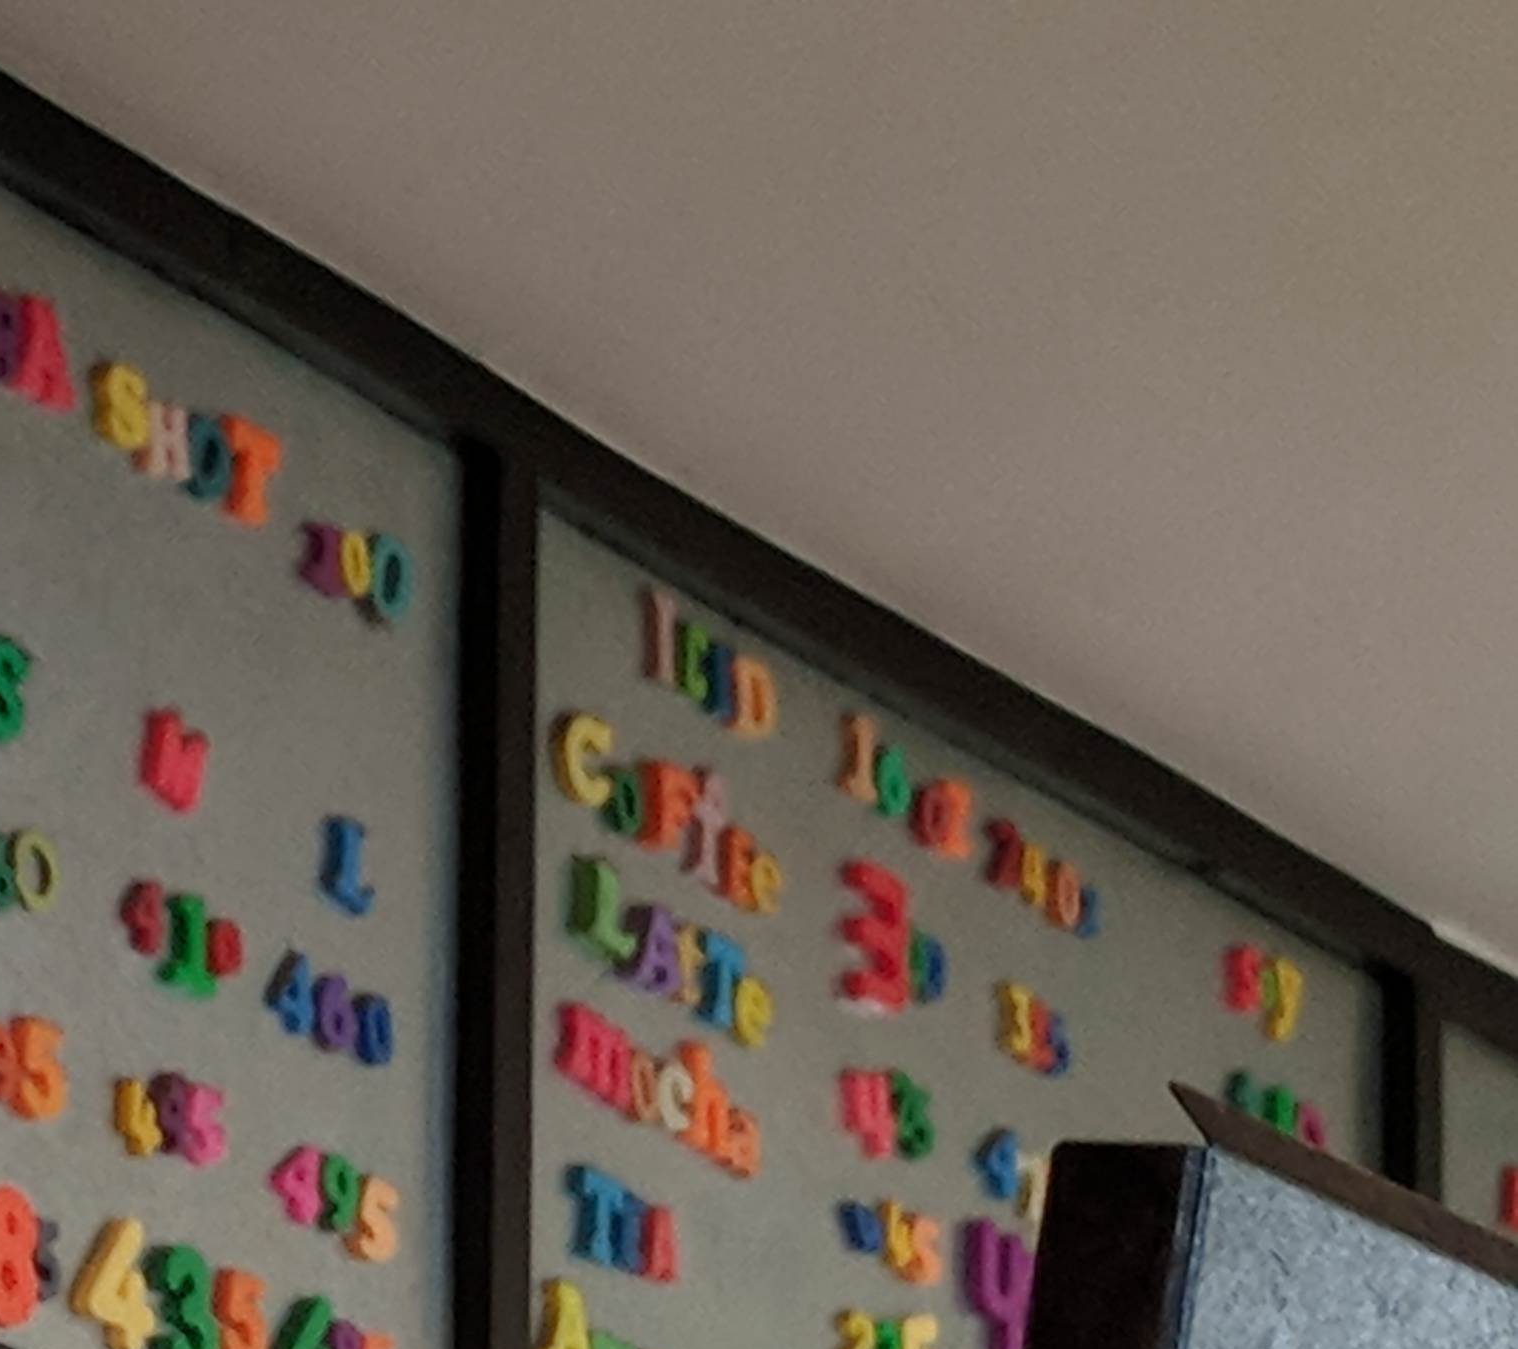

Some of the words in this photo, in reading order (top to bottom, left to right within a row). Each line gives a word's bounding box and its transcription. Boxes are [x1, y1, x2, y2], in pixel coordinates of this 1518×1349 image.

[89, 362, 282, 528] SHOT
[320, 814, 375, 914] L
[265, 948, 394, 1067] 460
[270, 1143, 399, 1263] 495
